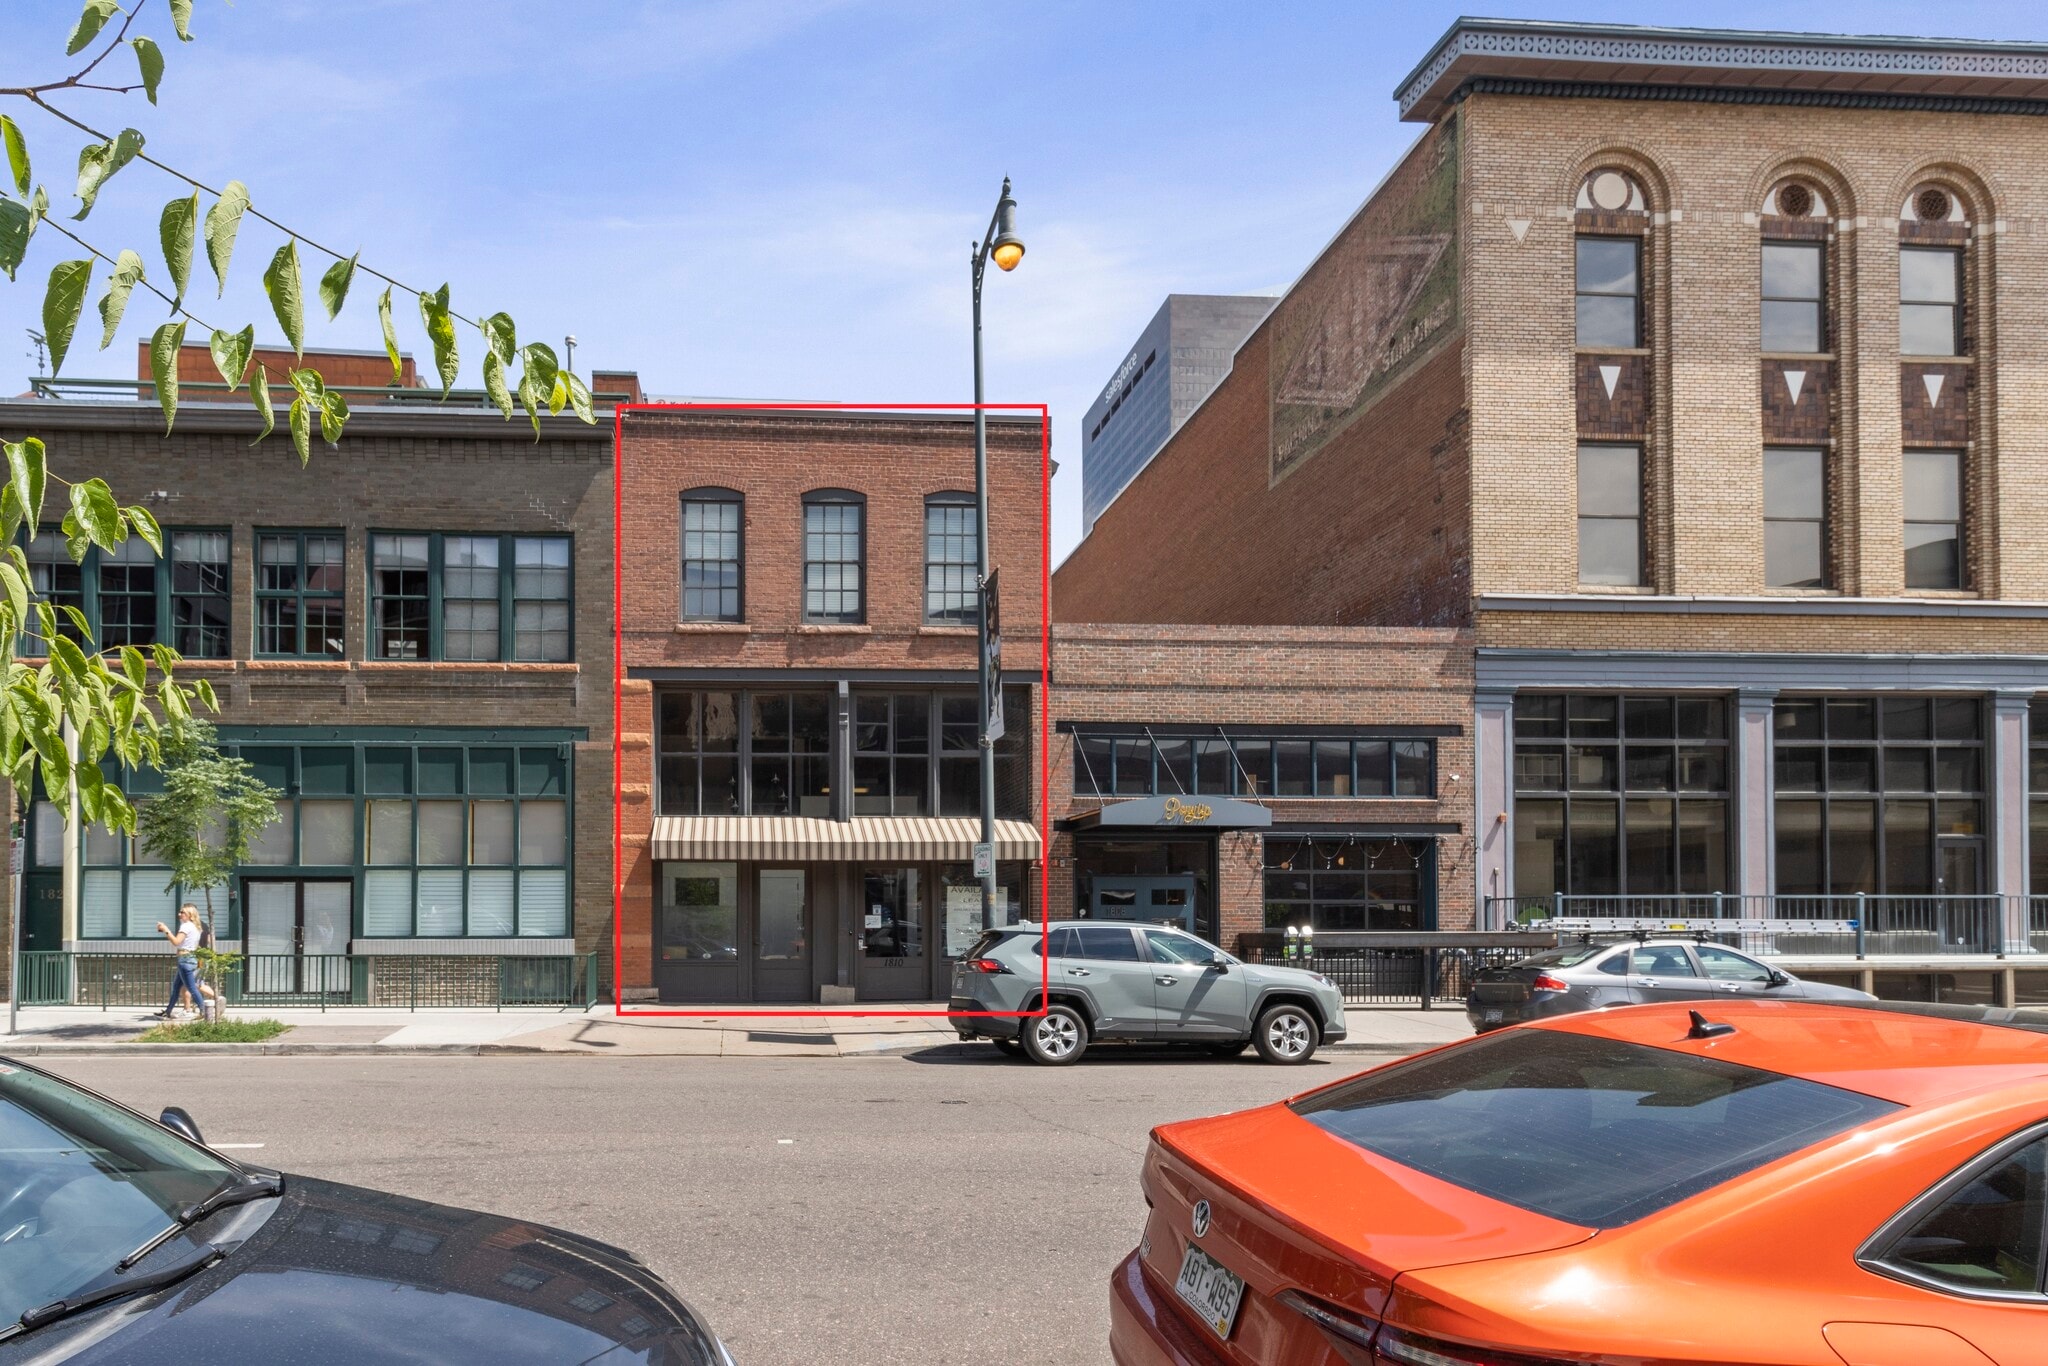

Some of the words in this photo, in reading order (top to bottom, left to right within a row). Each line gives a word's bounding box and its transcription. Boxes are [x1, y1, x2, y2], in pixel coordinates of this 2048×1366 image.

[1105, 353, 1137, 404] salesforce
[884, 958, 904, 968] 1810
[1188, 1291, 1216, 1321] COLORADO
